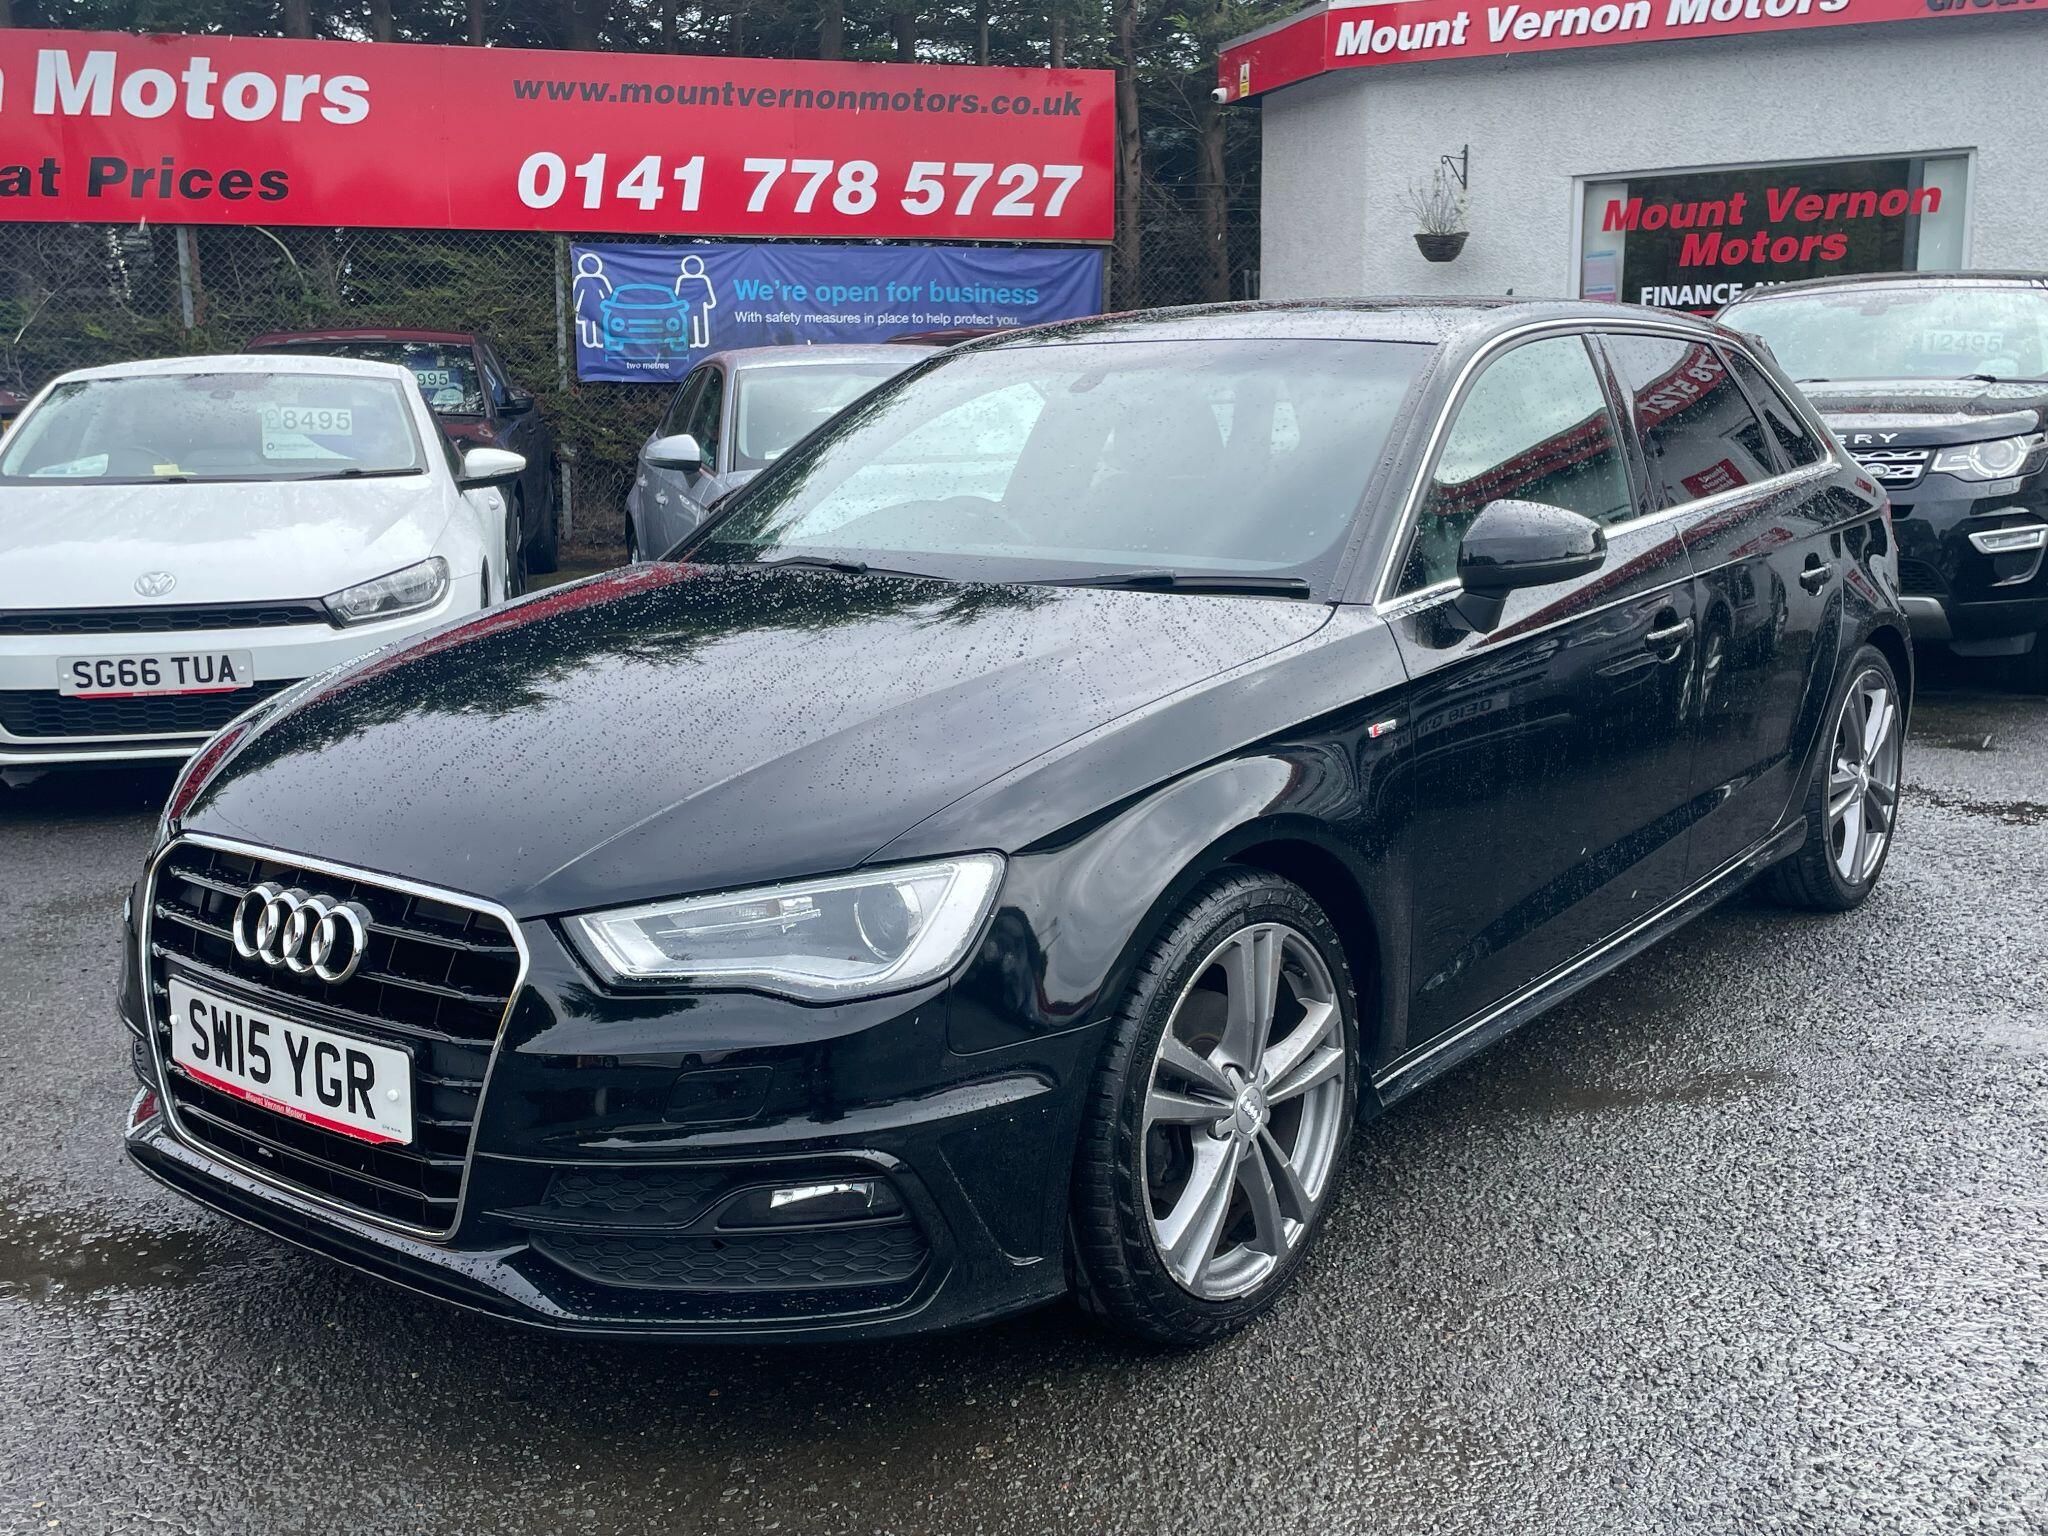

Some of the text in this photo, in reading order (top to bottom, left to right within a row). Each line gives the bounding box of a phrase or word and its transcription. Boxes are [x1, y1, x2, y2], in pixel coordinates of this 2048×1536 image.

[1335, 11, 1470, 56] Mount
[1488, 0, 1651, 43] Vernon
[34, 49, 371, 124] Motors
[513, 79, 1083, 116] www.mountvernonmotors.co.uk
[87, 157, 290, 200] Prices
[517, 151, 1084, 217] 0141 778 5727
[1602, 186, 1942, 232] Mount Vernon
[1679, 231, 1848, 267] Motors
[815, 286, 879, 306] open
[886, 281, 923, 302] for
[930, 280, 1040, 304] business
[1640, 282, 1743, 306] FINANCE
[735, 311, 1021, 327] With safety measures in place to help protect you.
[1929, 334, 2001, 351] 12495
[417, 372, 448, 386] 995
[626, 361, 670, 370] two metres
[72, 655, 236, 688] SG66 TUA
[189, 998, 377, 1120] SW15 YGR
[263, 1099, 285, 1114] Vernon
[285, 1106, 307, 1121] Motors
